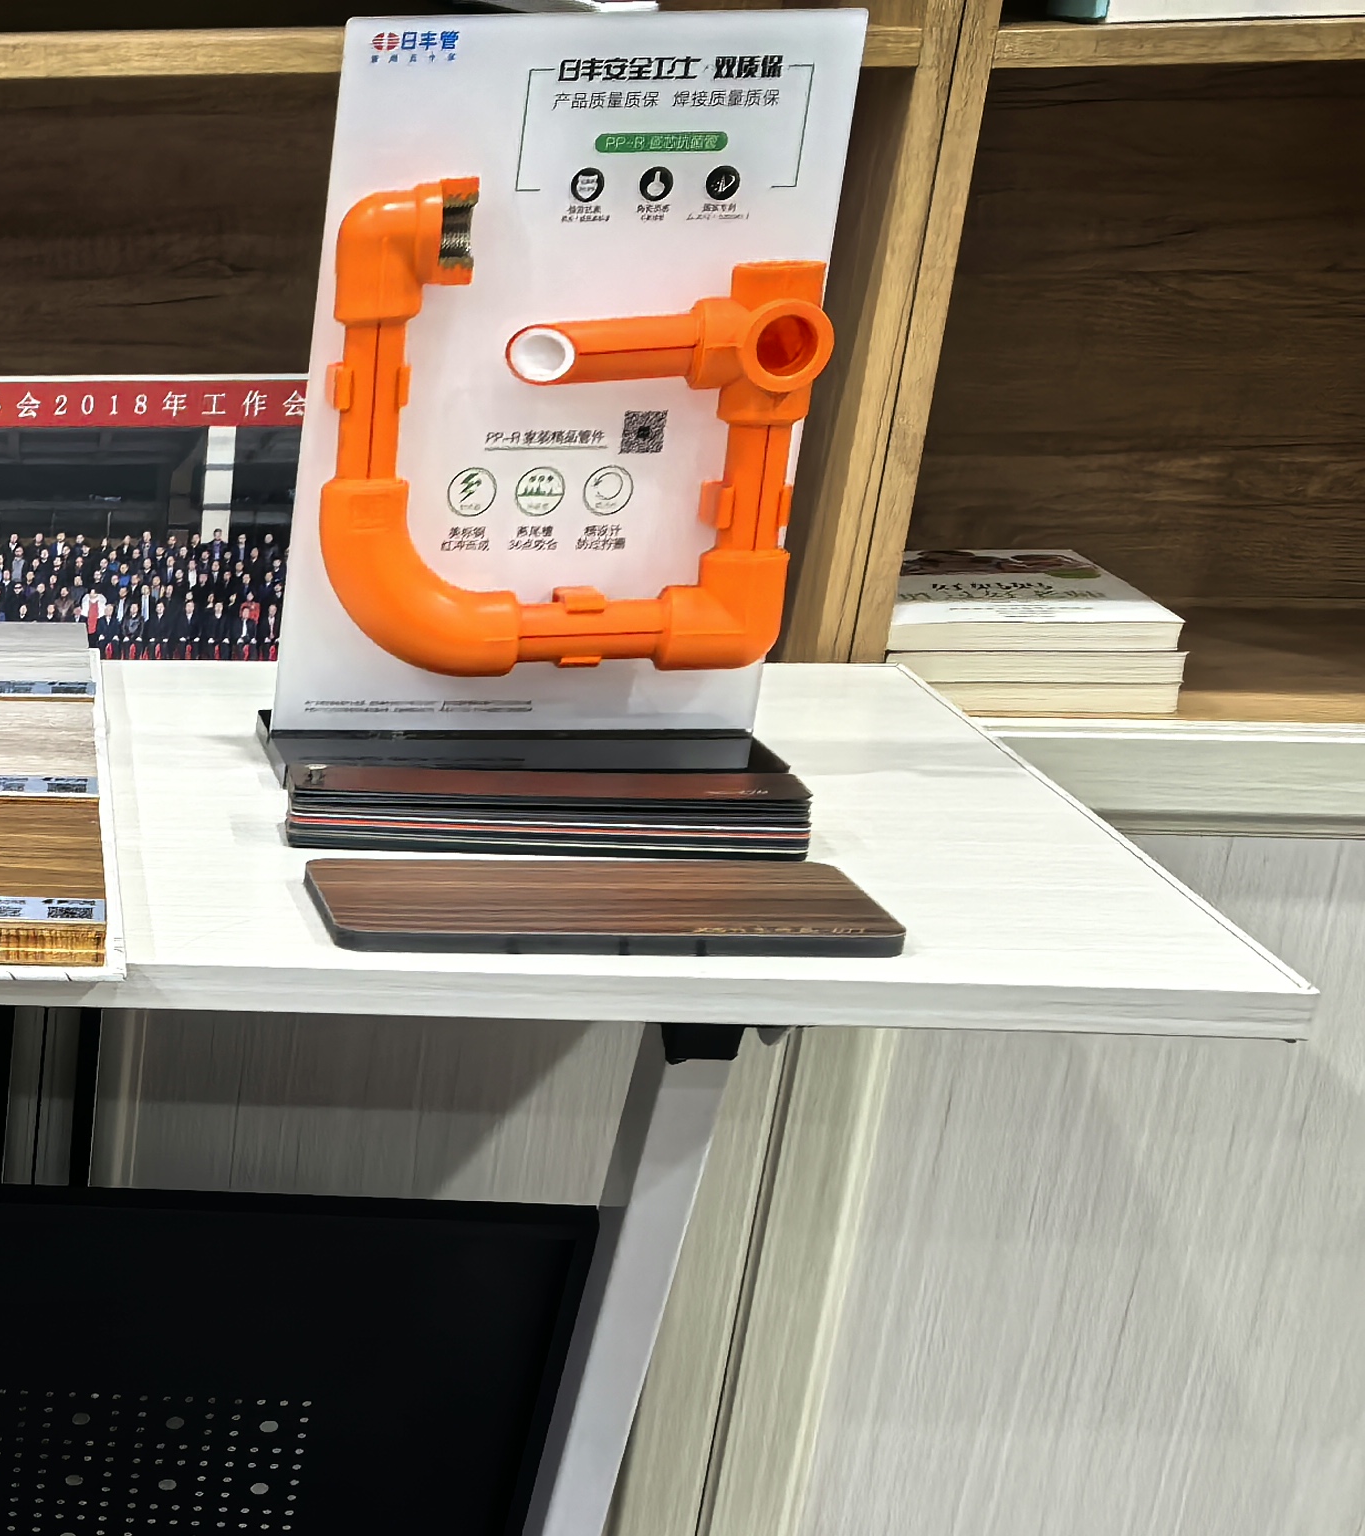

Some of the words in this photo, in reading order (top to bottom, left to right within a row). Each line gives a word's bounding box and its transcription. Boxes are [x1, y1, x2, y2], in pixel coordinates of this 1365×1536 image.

[401, 30, 459, 50] 日丰管
[552, 91, 659, 110] 产品质量质保
[672, 89, 780, 109] 焊接质量质保
